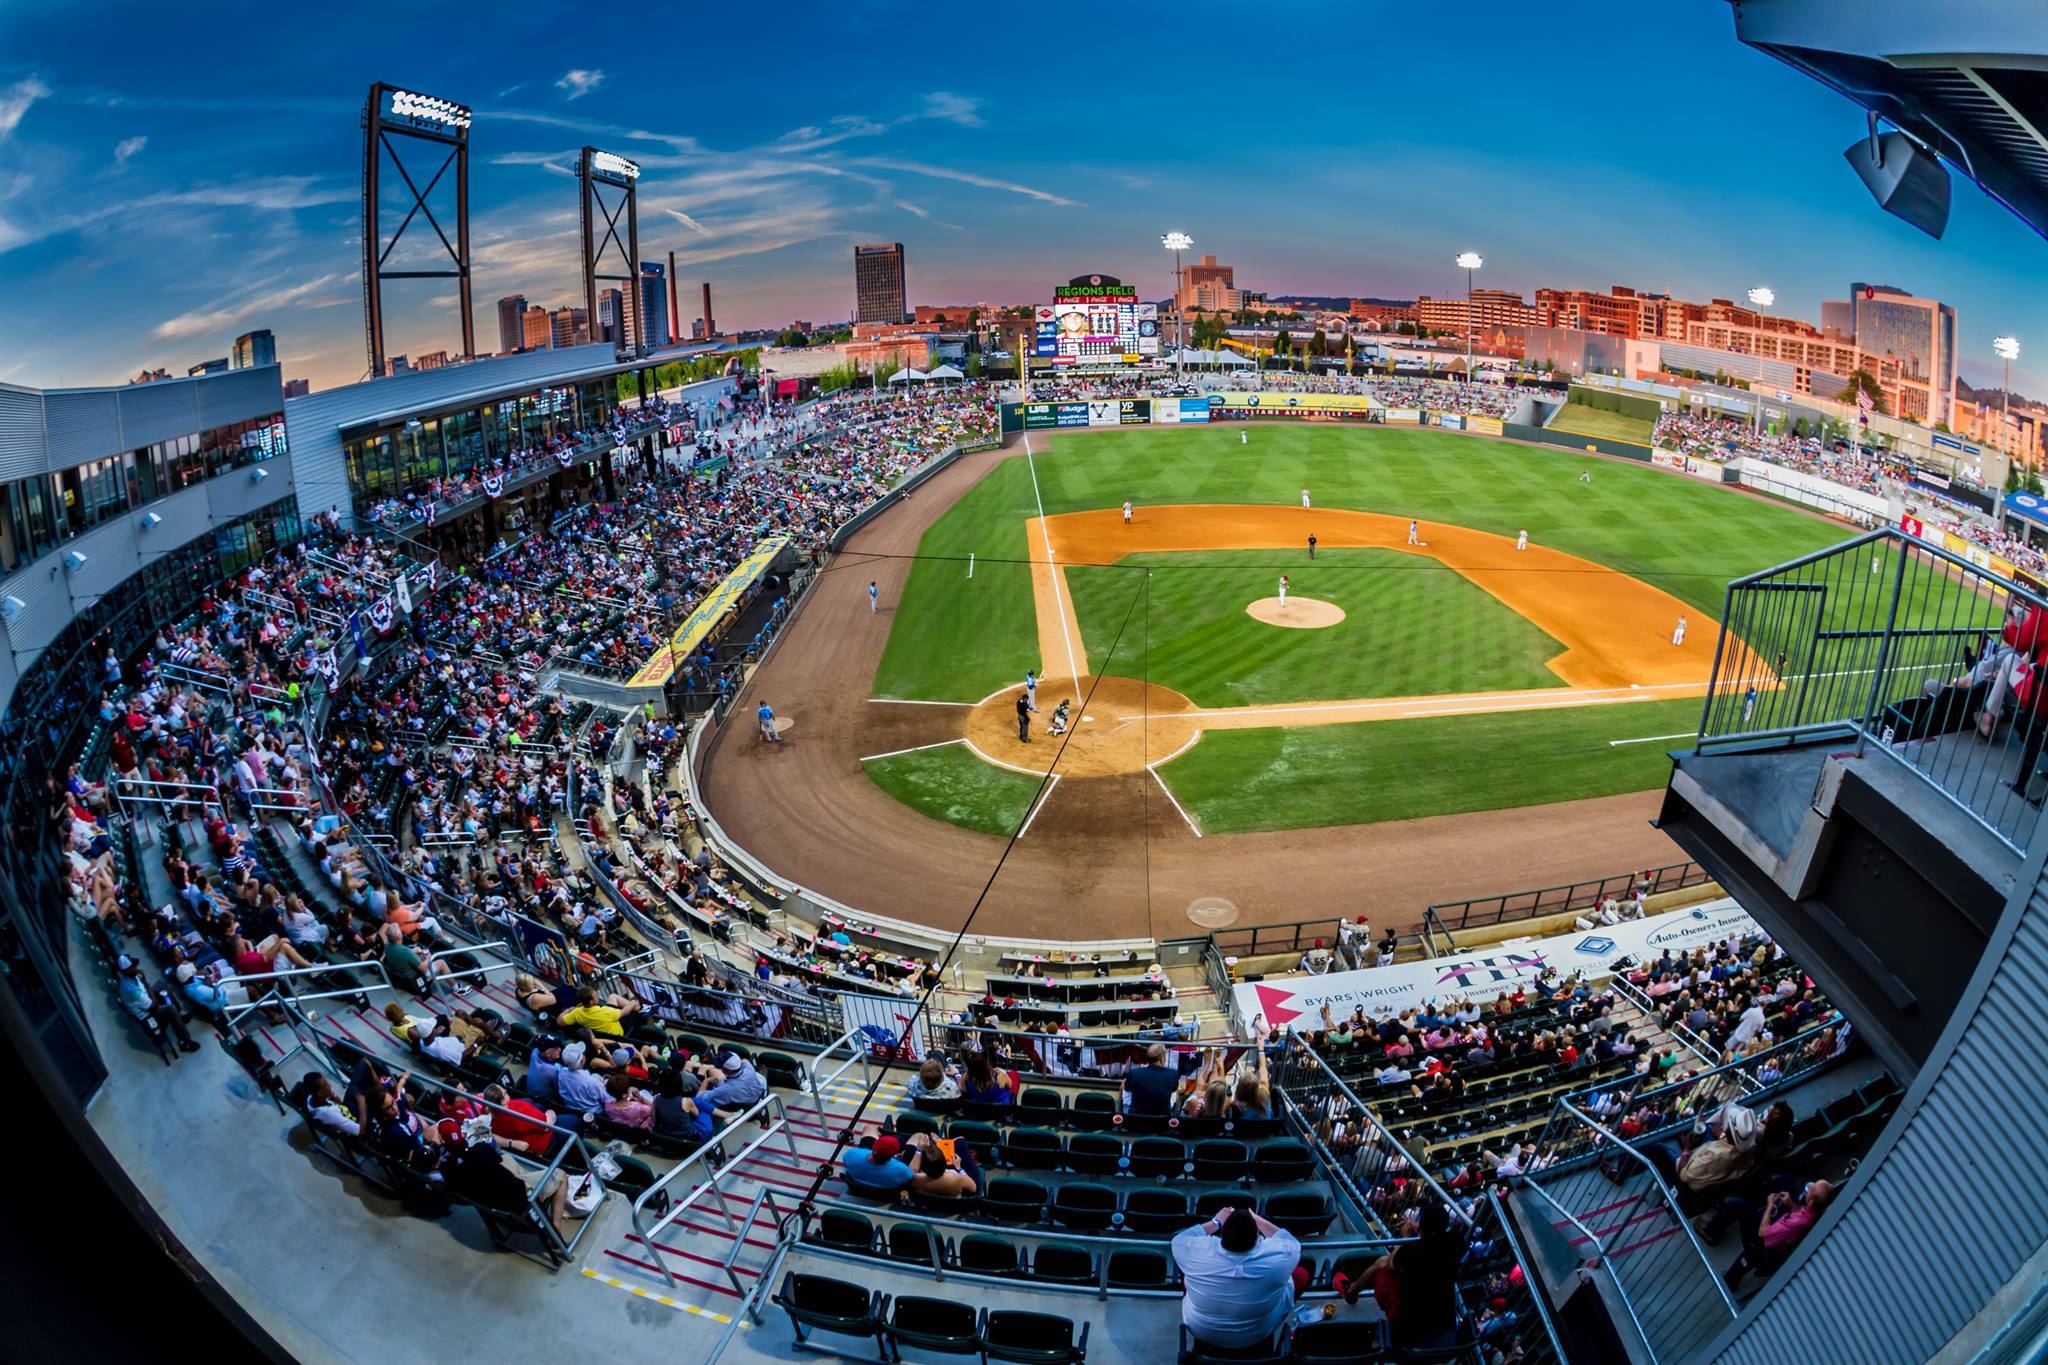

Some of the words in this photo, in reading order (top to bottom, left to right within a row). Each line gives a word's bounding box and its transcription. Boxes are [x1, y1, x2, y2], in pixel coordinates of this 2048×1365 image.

[1057, 287, 1104, 296] REGIONS
[1106, 287, 1135, 296] FIELD
[1649, 924, 1716, 944] Auto-Owners
[1387, 945, 1394, 953] 7
[1314, 957, 1326, 966] 55
[1435, 949, 1548, 988] TIN
[1305, 993, 1353, 1006] BYARS
[1360, 984, 1416, 998] WRIGHT
[1463, 983, 1510, 999] Insurance
